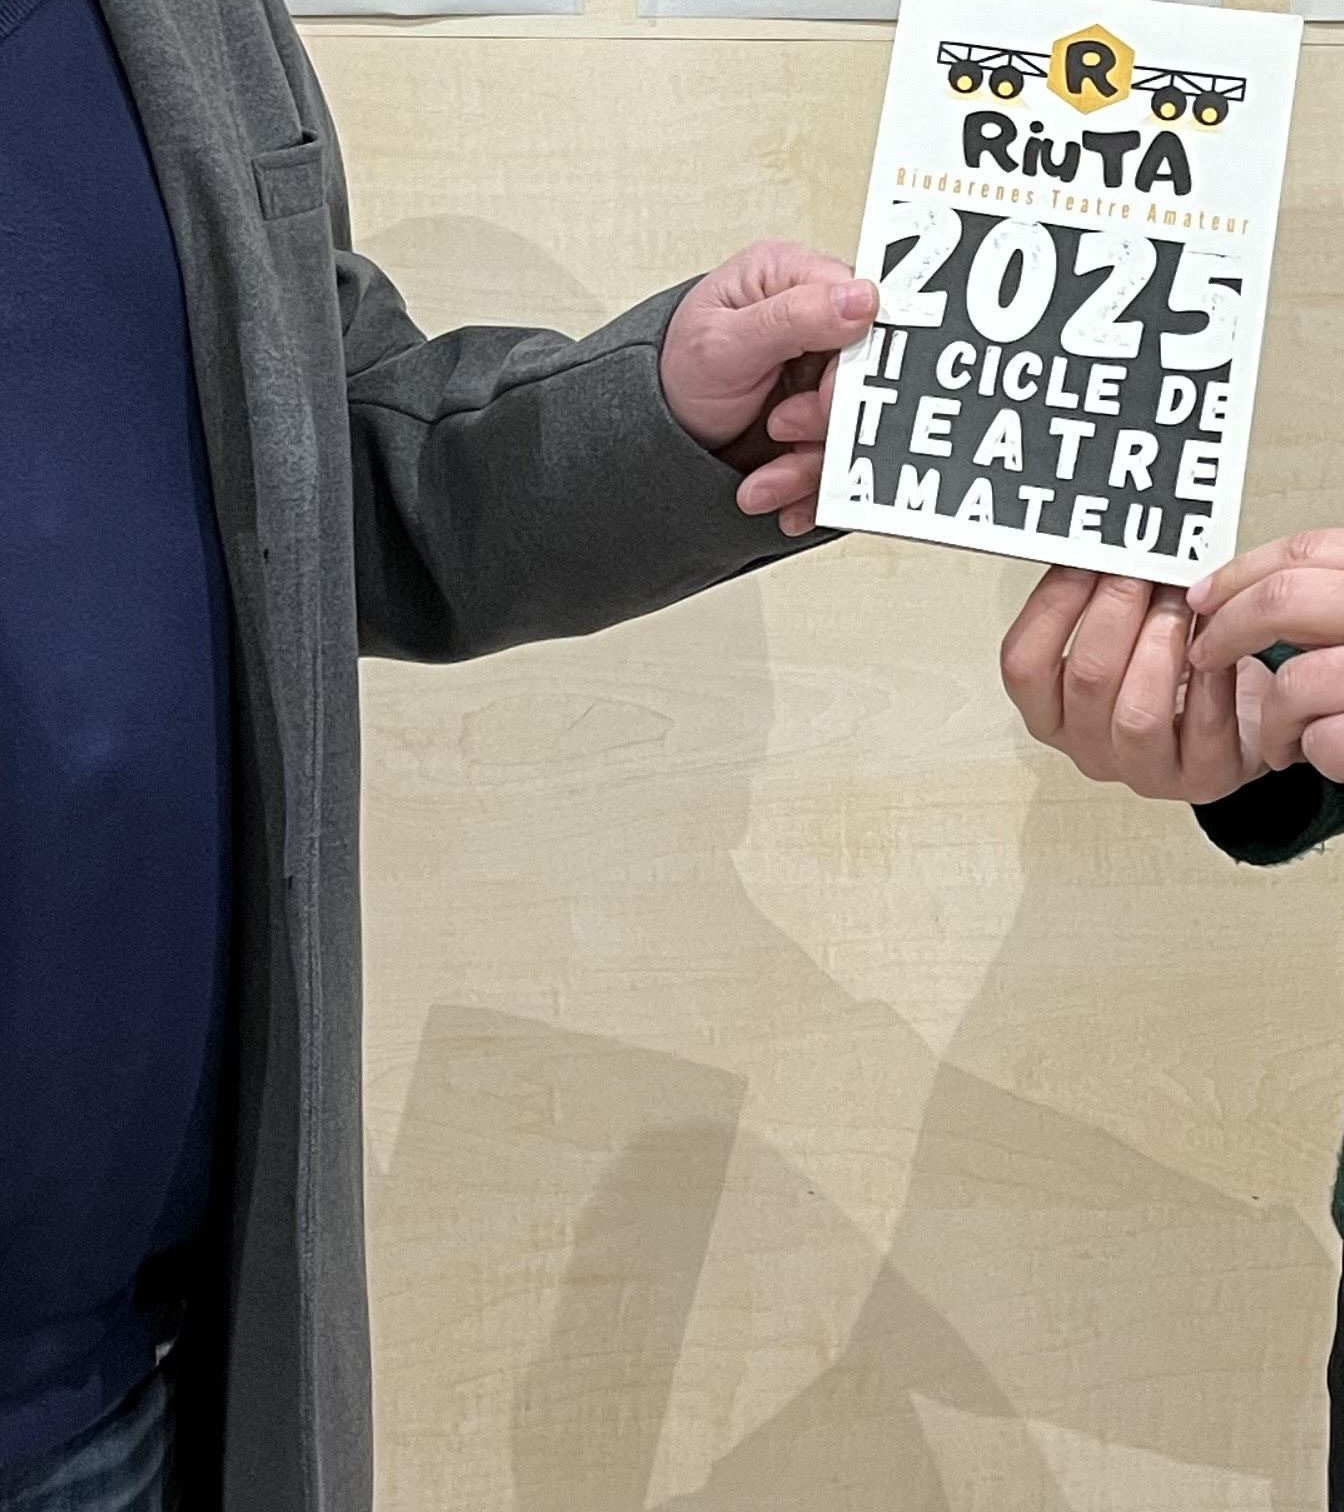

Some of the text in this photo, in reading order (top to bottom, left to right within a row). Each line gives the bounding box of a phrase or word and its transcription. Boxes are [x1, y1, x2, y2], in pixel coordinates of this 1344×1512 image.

[1064, 40, 1119, 99] R
[896, 167, 1251, 235] Riudarenes Teatre Amateur
[962, 110, 1193, 197] RiuTA
[877, 202, 1242, 372] 2025
[935, 339, 1129, 416] CICLE
[1156, 373, 1229, 434] DE
[859, 386, 1218, 503] TEATRE
[849, 457, 1212, 562] AMATEUR
